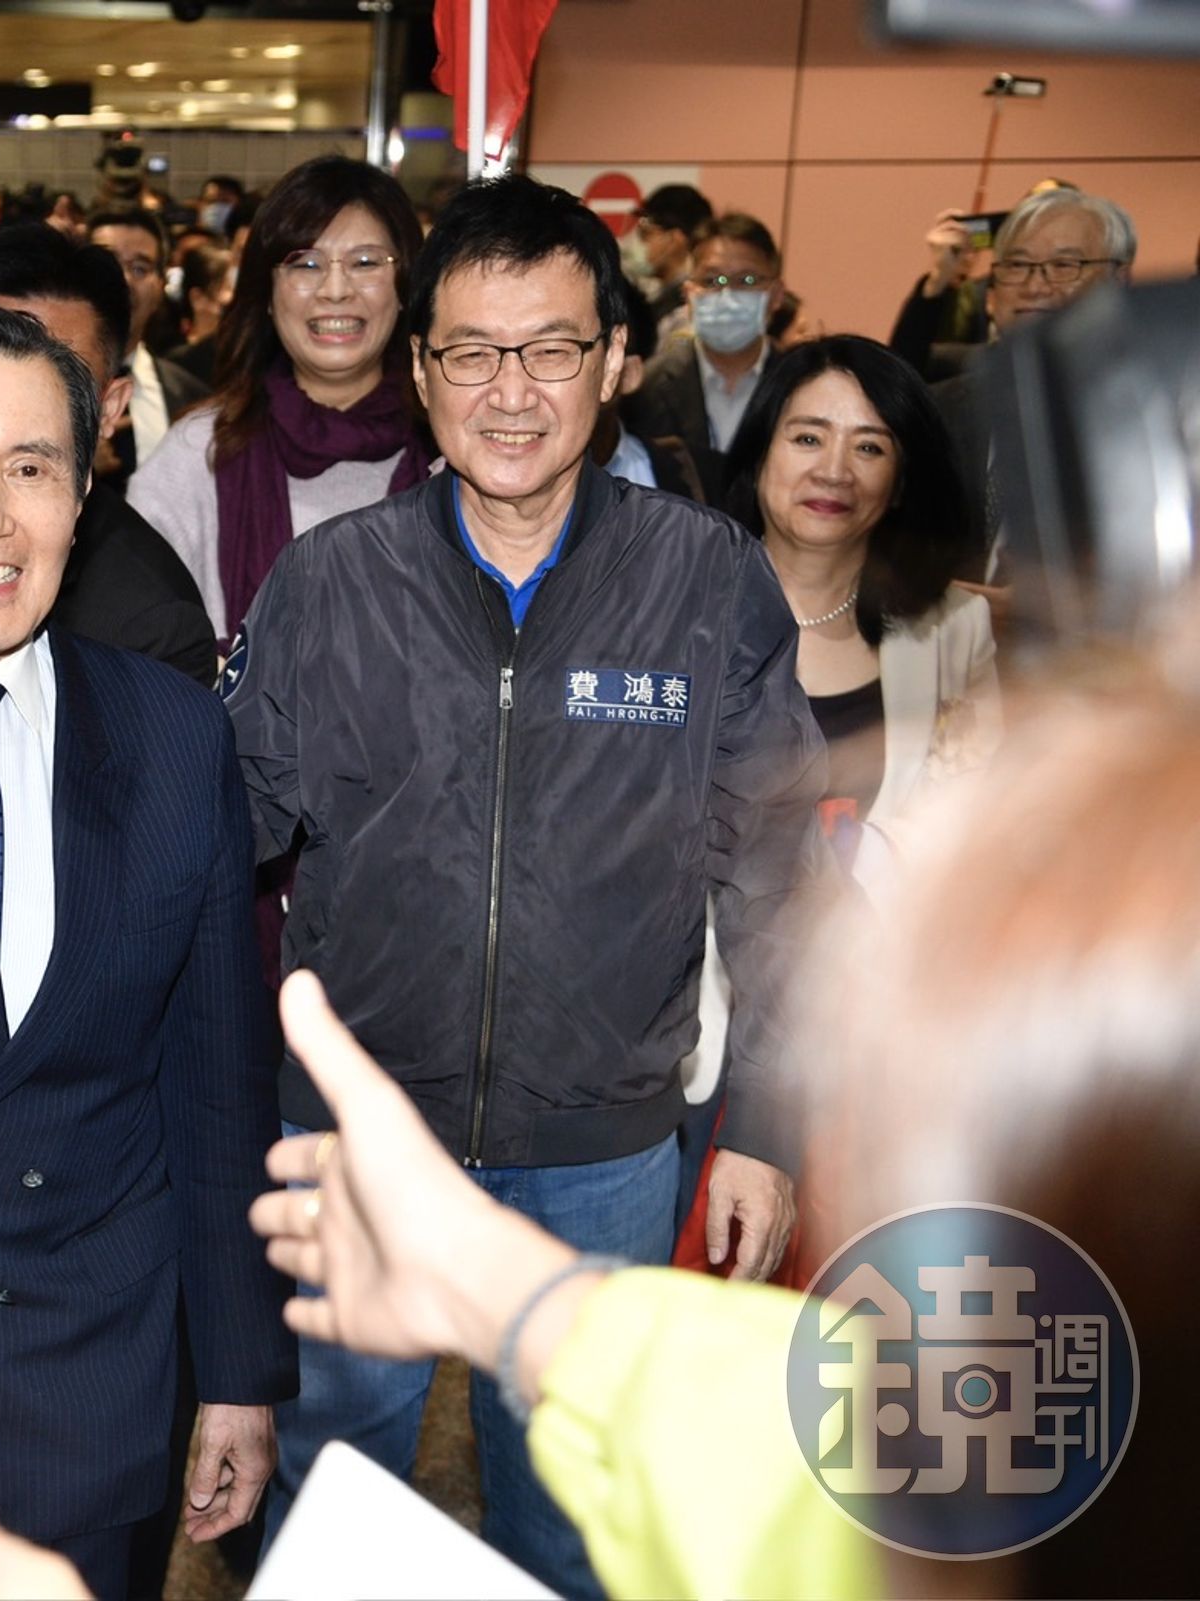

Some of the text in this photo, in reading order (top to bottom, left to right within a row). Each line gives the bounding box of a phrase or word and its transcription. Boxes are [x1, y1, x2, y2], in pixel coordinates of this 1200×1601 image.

[567, 670, 688, 708] 費 鴻泰
[606, 708, 685, 723] HRONG-TAI
